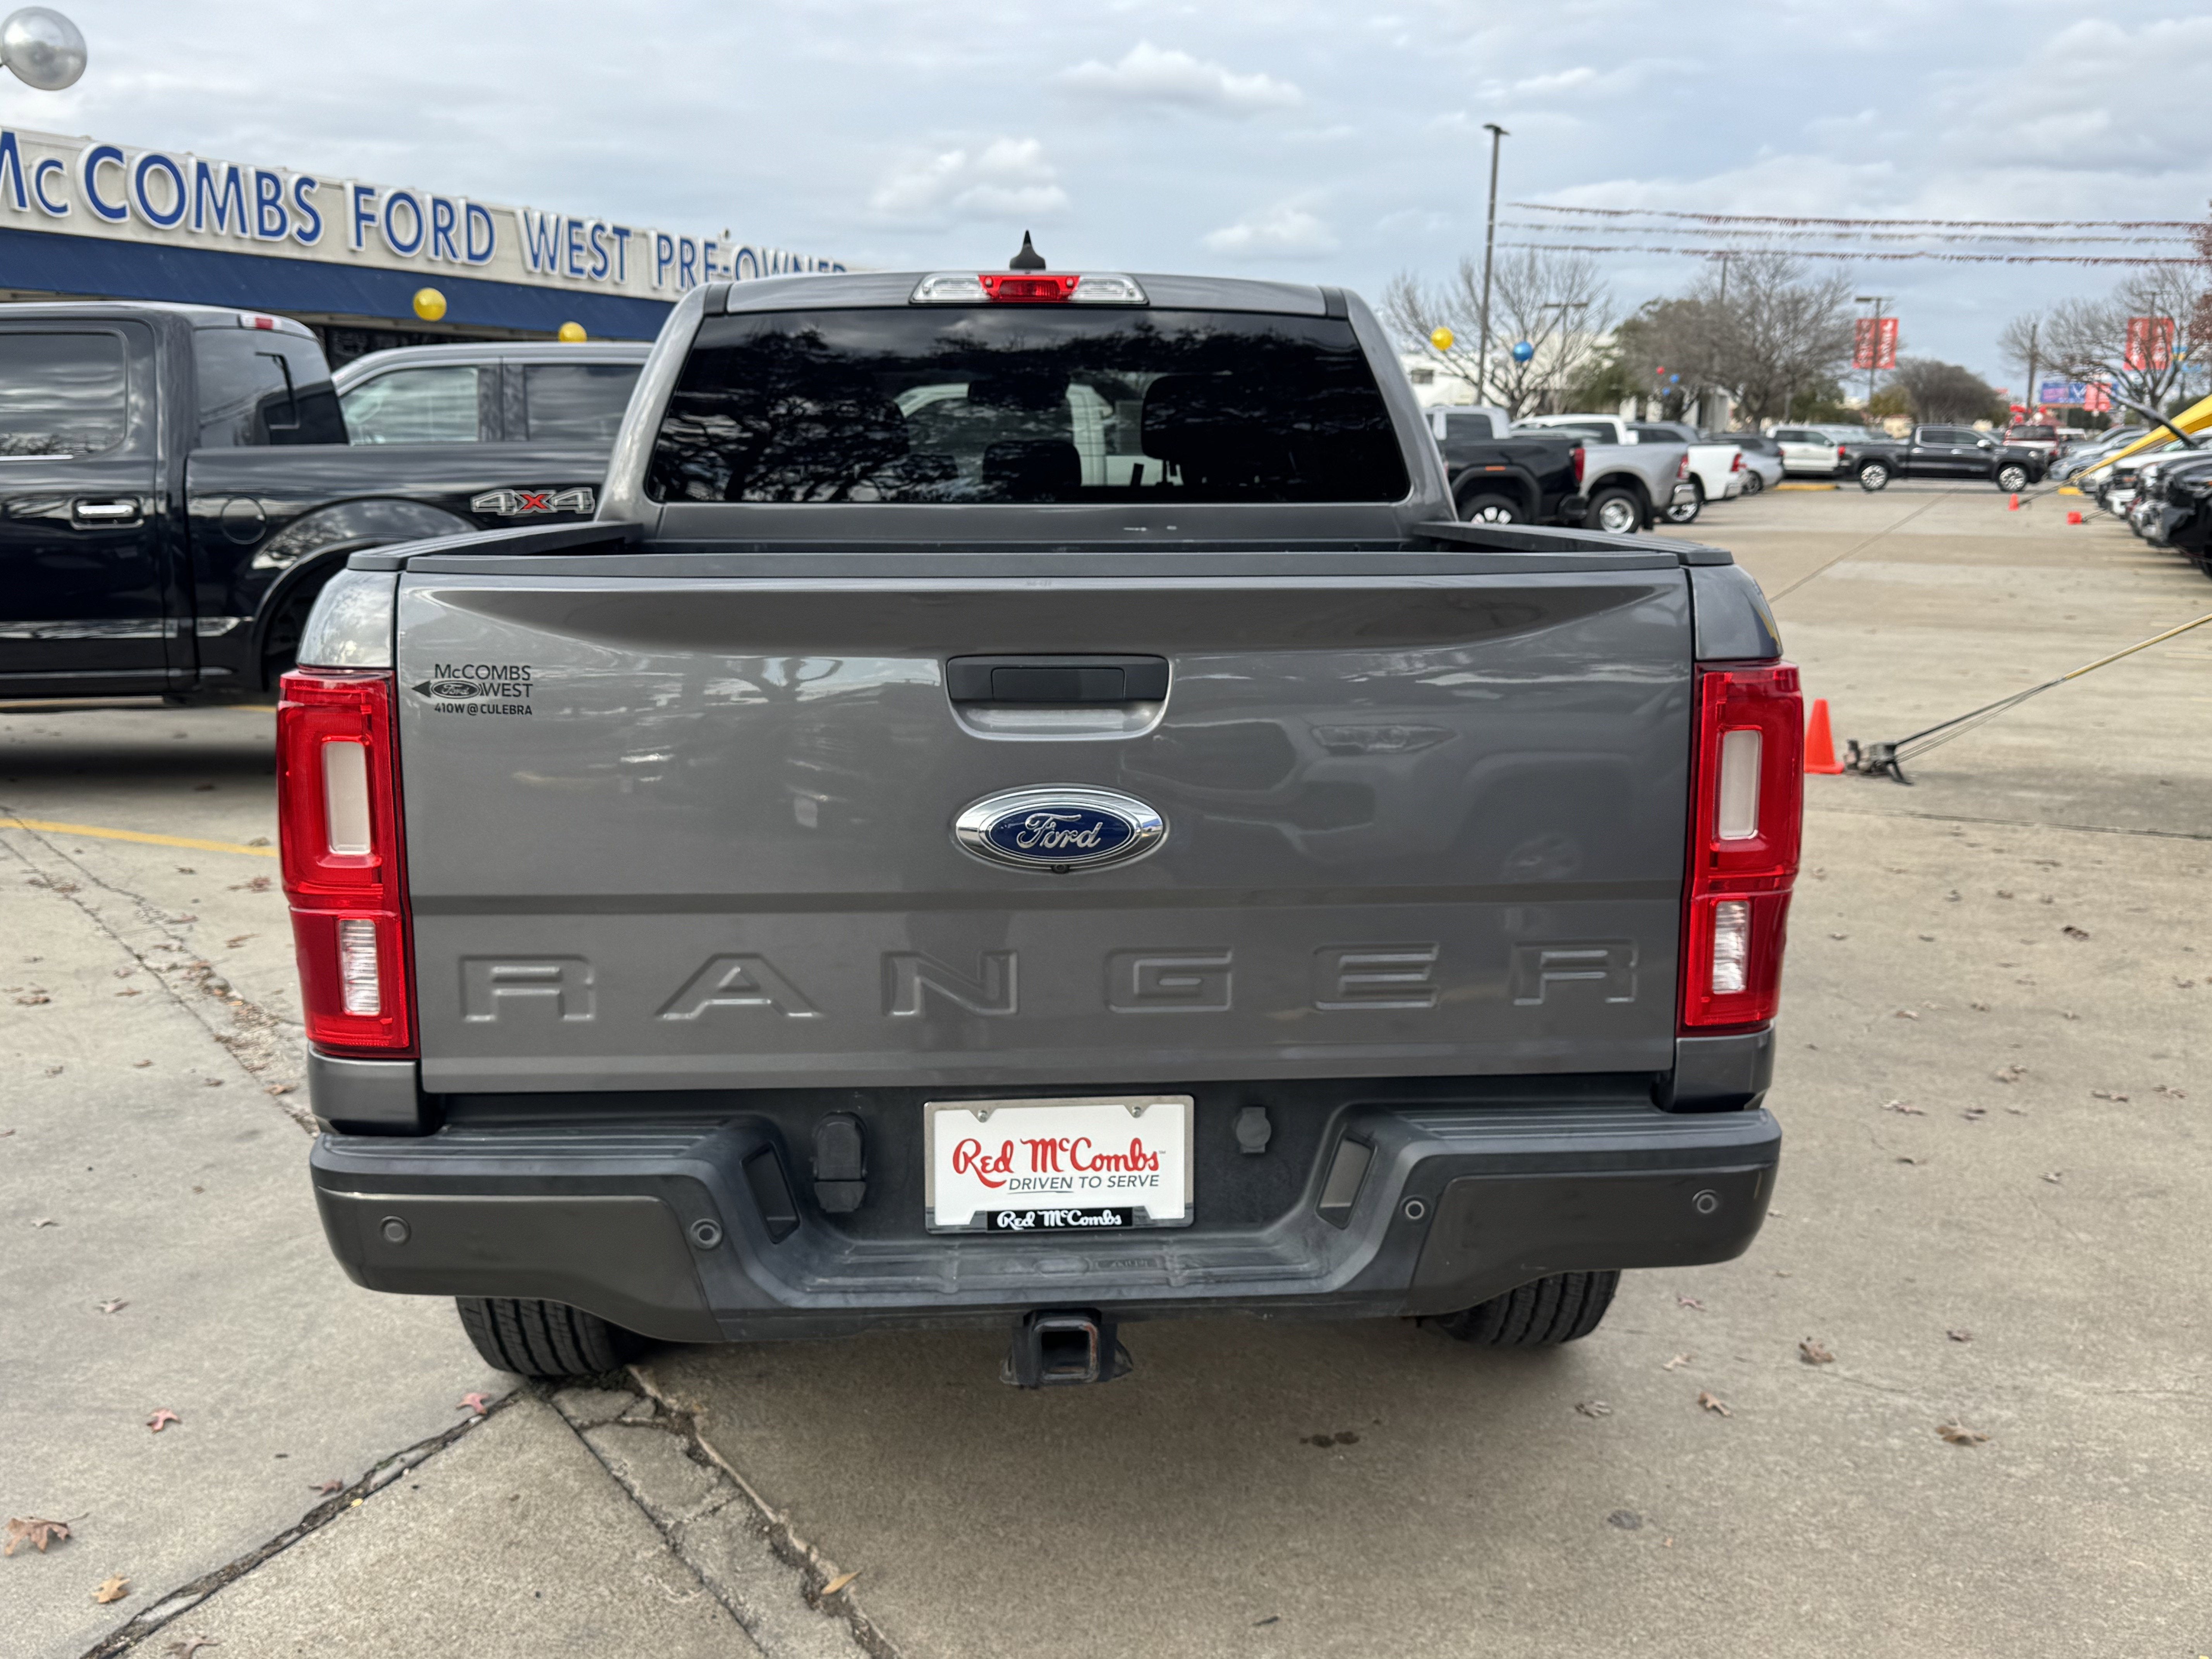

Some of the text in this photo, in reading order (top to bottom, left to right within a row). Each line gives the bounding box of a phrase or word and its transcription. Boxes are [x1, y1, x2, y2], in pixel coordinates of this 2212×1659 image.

[345, 180, 496, 266] FORD
[517, 208, 632, 284] WEST
[649, 232, 847, 290] PRE-OW
[434, 663, 531, 680] McCOMBS
[441, 683, 533, 697] Ford WEST
[1016, 812, 1102, 849] Ford
[459, 939, 1638, 1022] RANGER
[952, 1137, 1159, 1188] Red McCombs
[1008, 1174, 1159, 1190] DRIVEN TO SERVE
[997, 1209, 1122, 1230] Red McCombs
